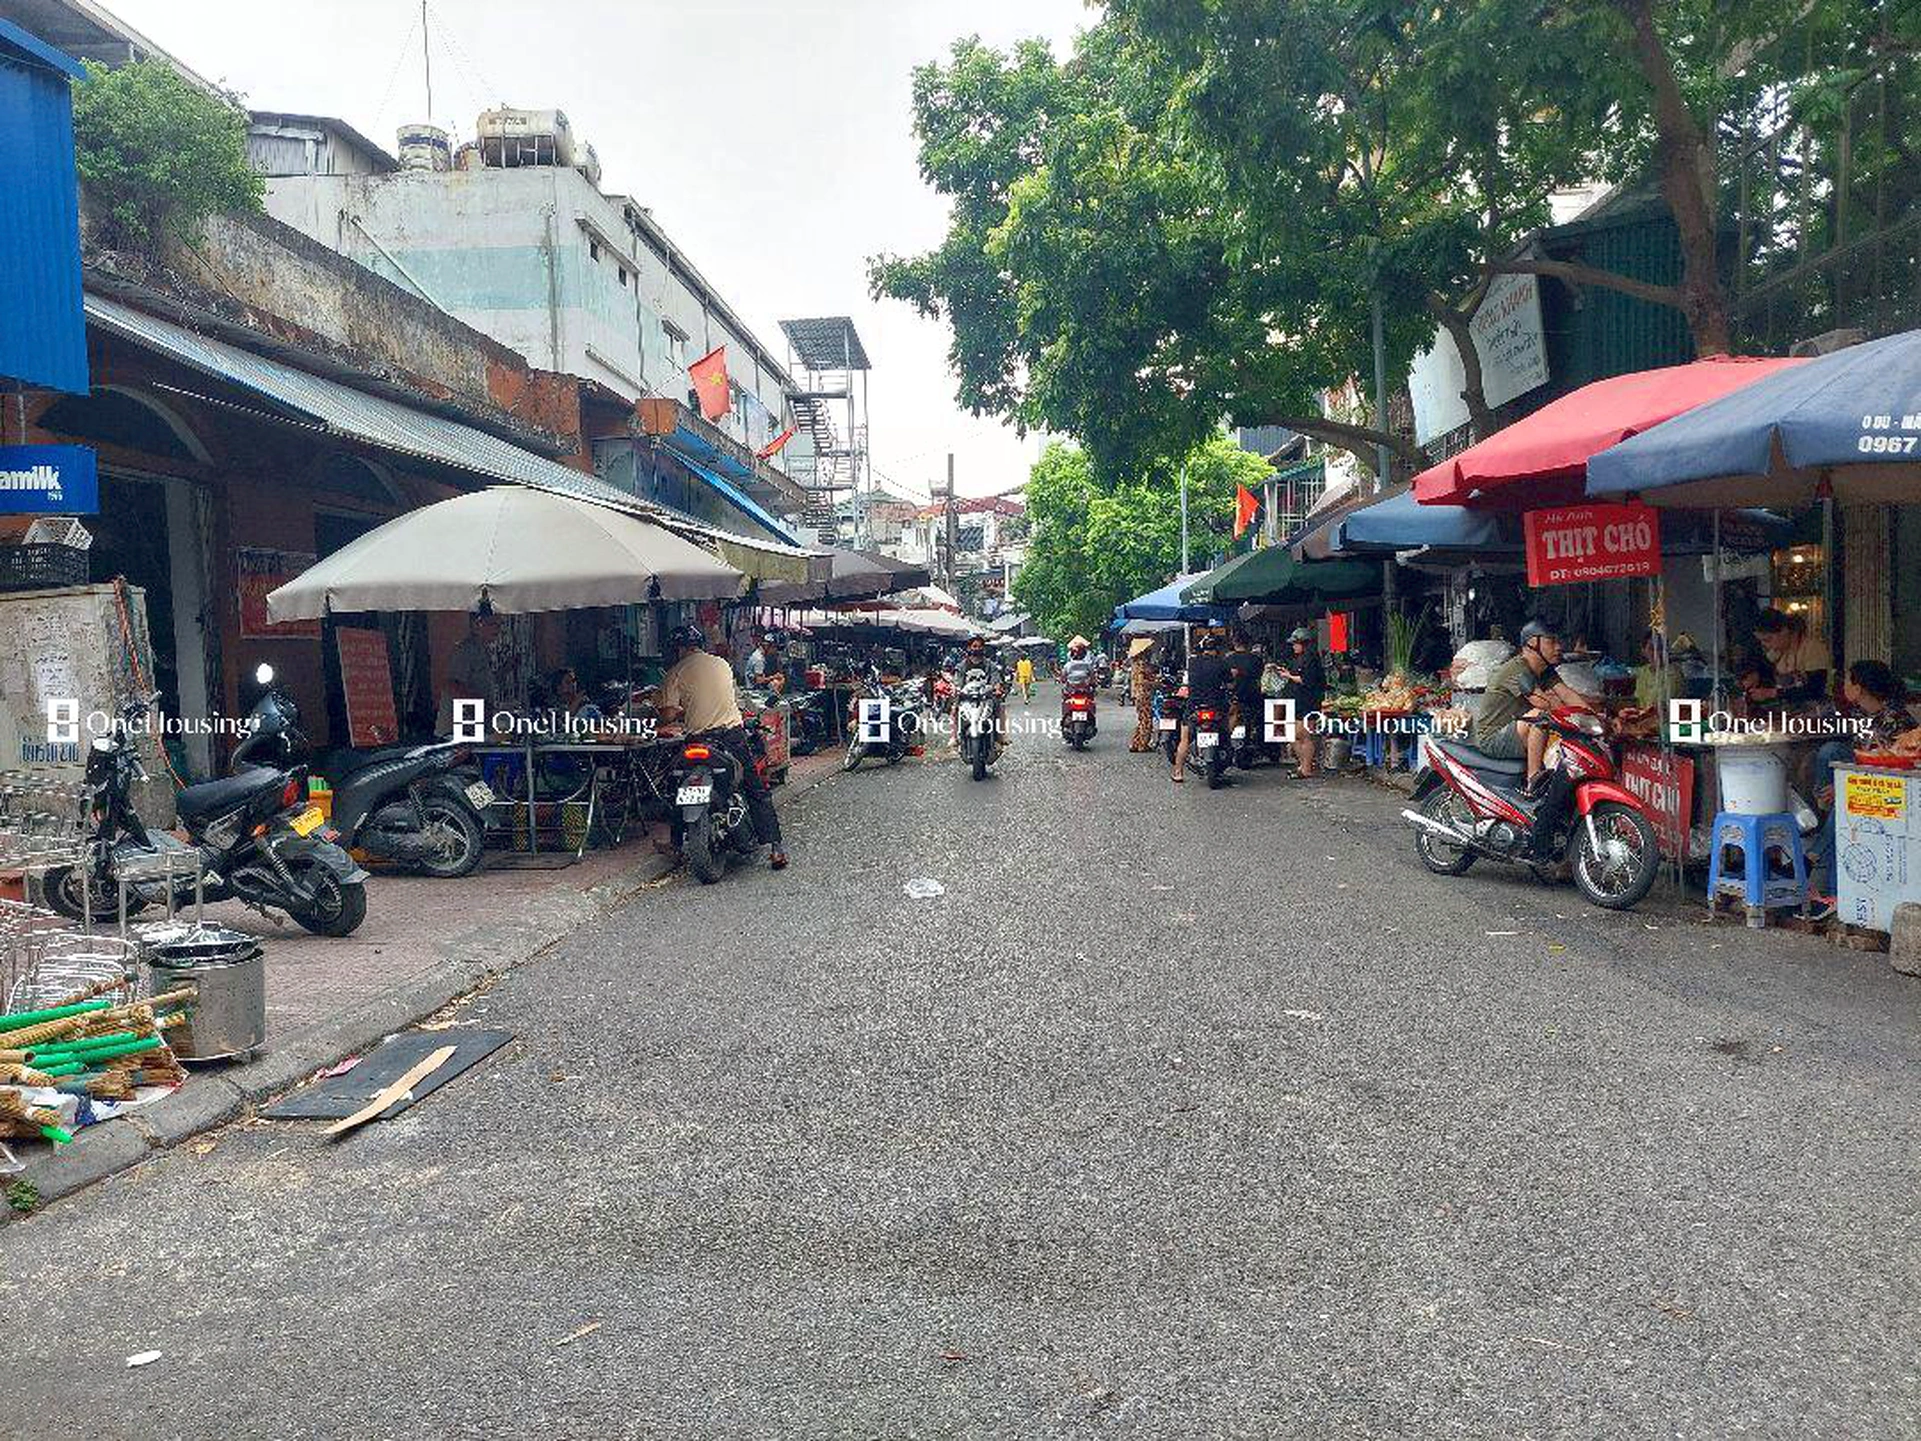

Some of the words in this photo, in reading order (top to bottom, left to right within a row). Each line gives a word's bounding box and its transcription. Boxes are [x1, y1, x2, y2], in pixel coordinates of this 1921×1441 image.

[1858, 435, 1919, 454] 0967
[1542, 525, 1598, 563] THỊT
[1604, 514, 1652, 554] CHÓ
